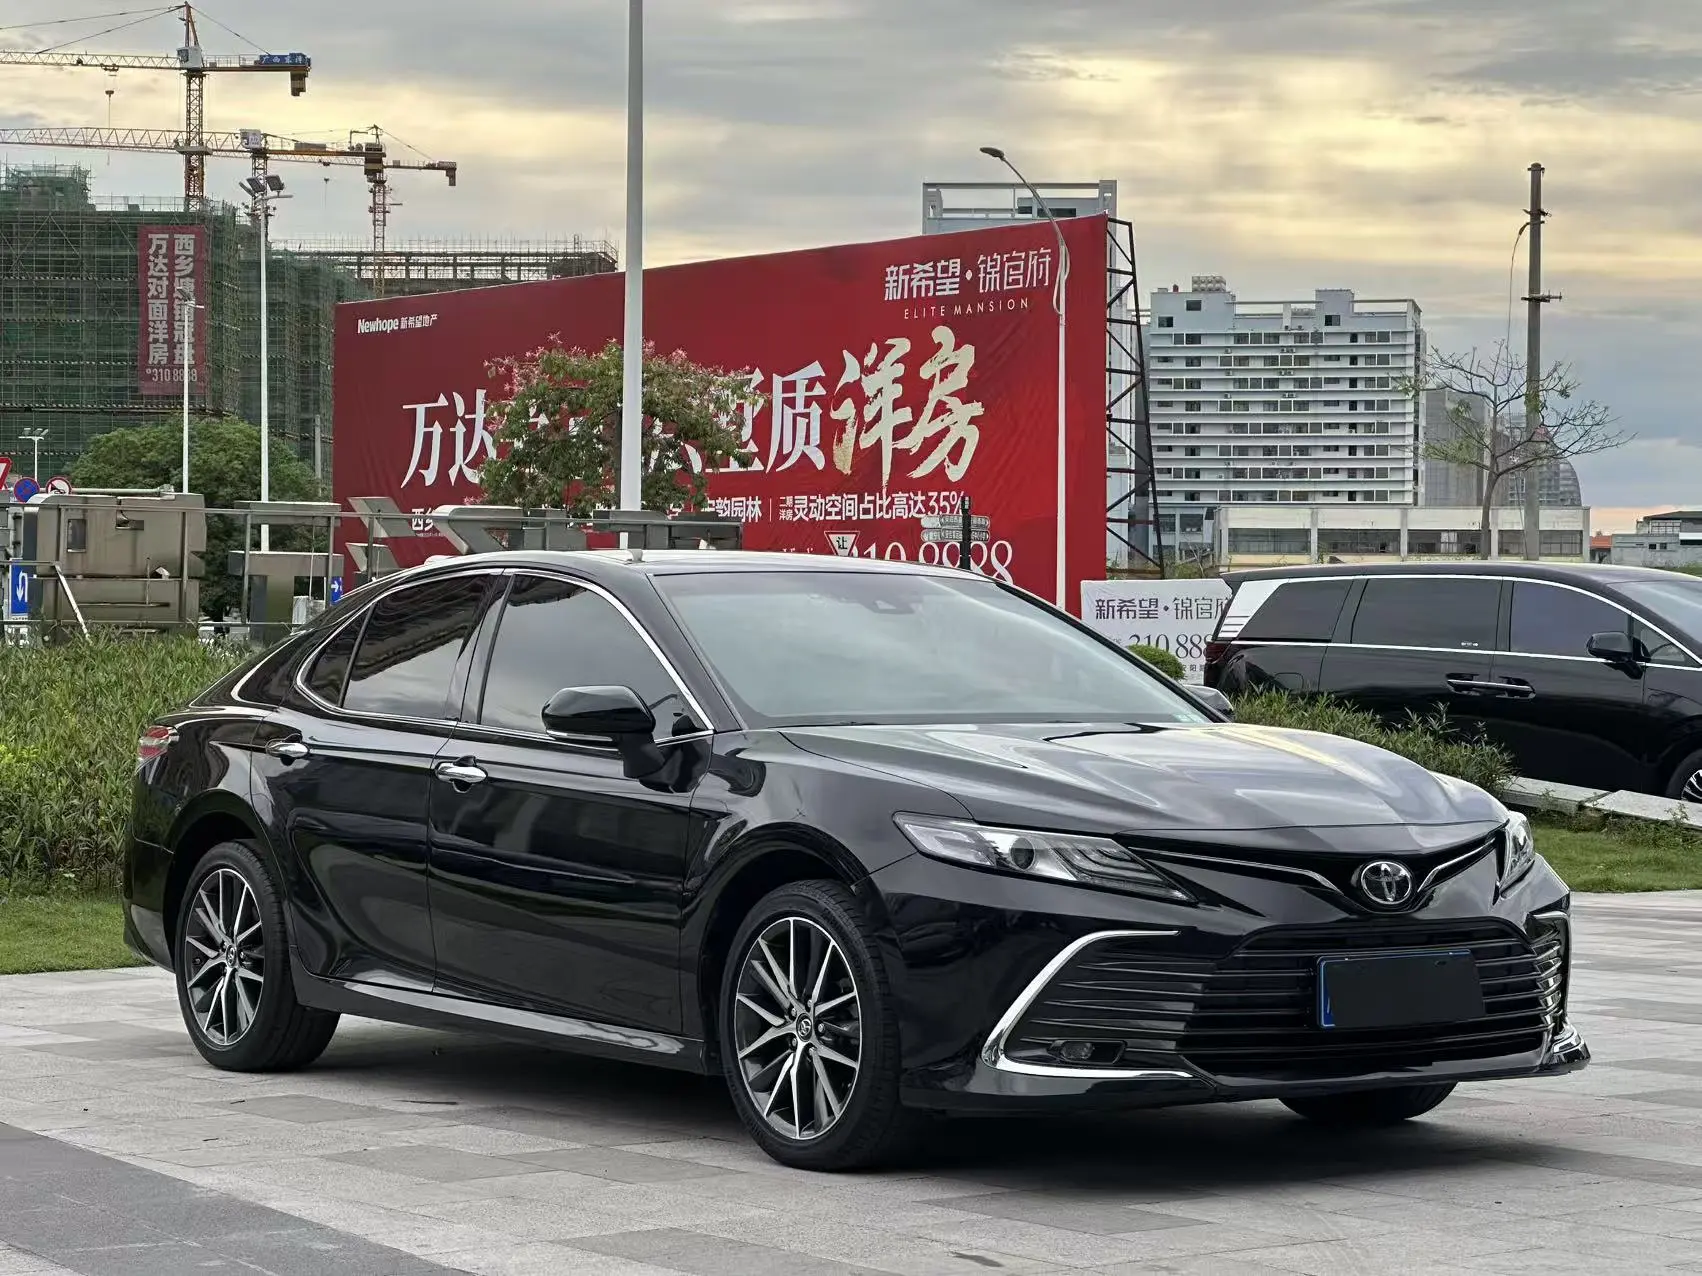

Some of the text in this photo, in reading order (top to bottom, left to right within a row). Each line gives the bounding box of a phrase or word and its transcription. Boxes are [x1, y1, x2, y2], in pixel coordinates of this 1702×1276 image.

[884, 247, 1052, 300] 新希望·锦官府
[147, 234, 169, 364] 万达对面洋房
[904, 297, 1029, 319] ELITE MANSION
[357, 314, 438, 333] Newhope 新希望地产
[836, 536, 848, 550] 让
